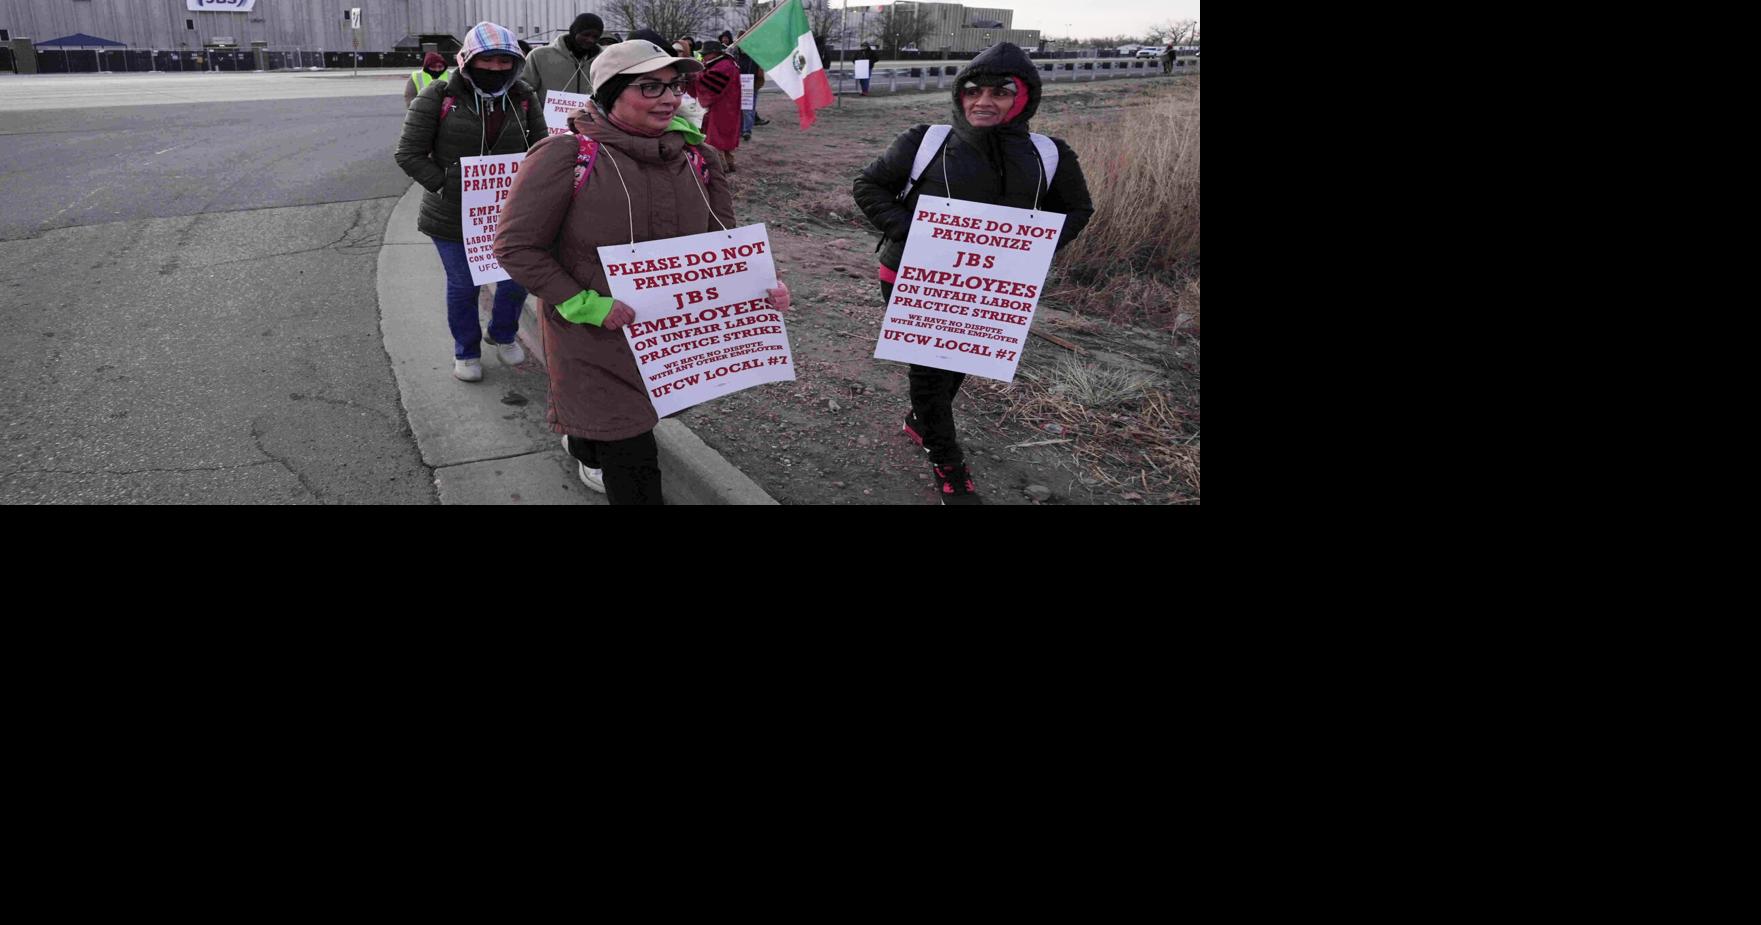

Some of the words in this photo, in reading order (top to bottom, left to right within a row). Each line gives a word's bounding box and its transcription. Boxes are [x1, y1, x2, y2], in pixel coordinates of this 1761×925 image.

[547, 97, 577, 107] PLEASE
[464, 163, 506, 178] FAVOR
[464, 176, 512, 192] PRATRO
[469, 204, 502, 217] EMPL
[473, 217, 483, 226] EN
[487, 215, 501, 224] HU
[917, 211, 982, 229] PLEASE
[985, 221, 1013, 233] DO
[1016, 225, 1057, 240] NOT
[932, 228, 1032, 251] PATRONIZE
[469, 254, 484, 263] CON
[479, 262, 500, 272] UFC
[607, 257, 680, 276] PLEASE
[685, 251, 717, 267] DO
[721, 242, 766, 260] NOT
[953, 252, 996, 269] JBS
[633, 262, 748, 290] PATRONIZE
[901, 266, 1038, 299] EMPLOYEES
[673, 287, 719, 310] JBS
[893, 296, 970, 316] PRACTICE
[972, 309, 1028, 326] STRIKE
[897, 284, 920, 293] ON
[923, 287, 977, 304] UNFAIR
[980, 296, 1032, 313] LABOR
[634, 337, 658, 352] ON
[662, 324, 720, 343] UNFAIR
[725, 313, 780, 330] LABOR
[890, 317, 914, 326] WITH
[915, 322, 935, 330] ANY
[936, 325, 966, 335] OTHER
[968, 330, 1019, 345] EMPLOYER
[924, 317, 948, 326] HAVE
[964, 323, 1004, 335] DISPUTE
[639, 336, 720, 365] PRACTICE
[723, 325, 782, 343] STRIKE
[664, 361, 678, 370] WE
[680, 353, 705, 364] HAVE
[707, 350, 721, 358] NO
[723, 341, 764, 354] DISPUTE
[884, 329, 932, 346] UFCW
[934, 338, 992, 357] LOCAL
[996, 349, 1017, 362] #7
[649, 371, 673, 382] WITH
[675, 363, 694, 373] ANY
[696, 355, 729, 366] OTHER
[730, 344, 784, 358] EMPLOYER
[651, 374, 700, 398] UFCW
[704, 359, 764, 381] LOCAL
[768, 356, 788, 366] #7
